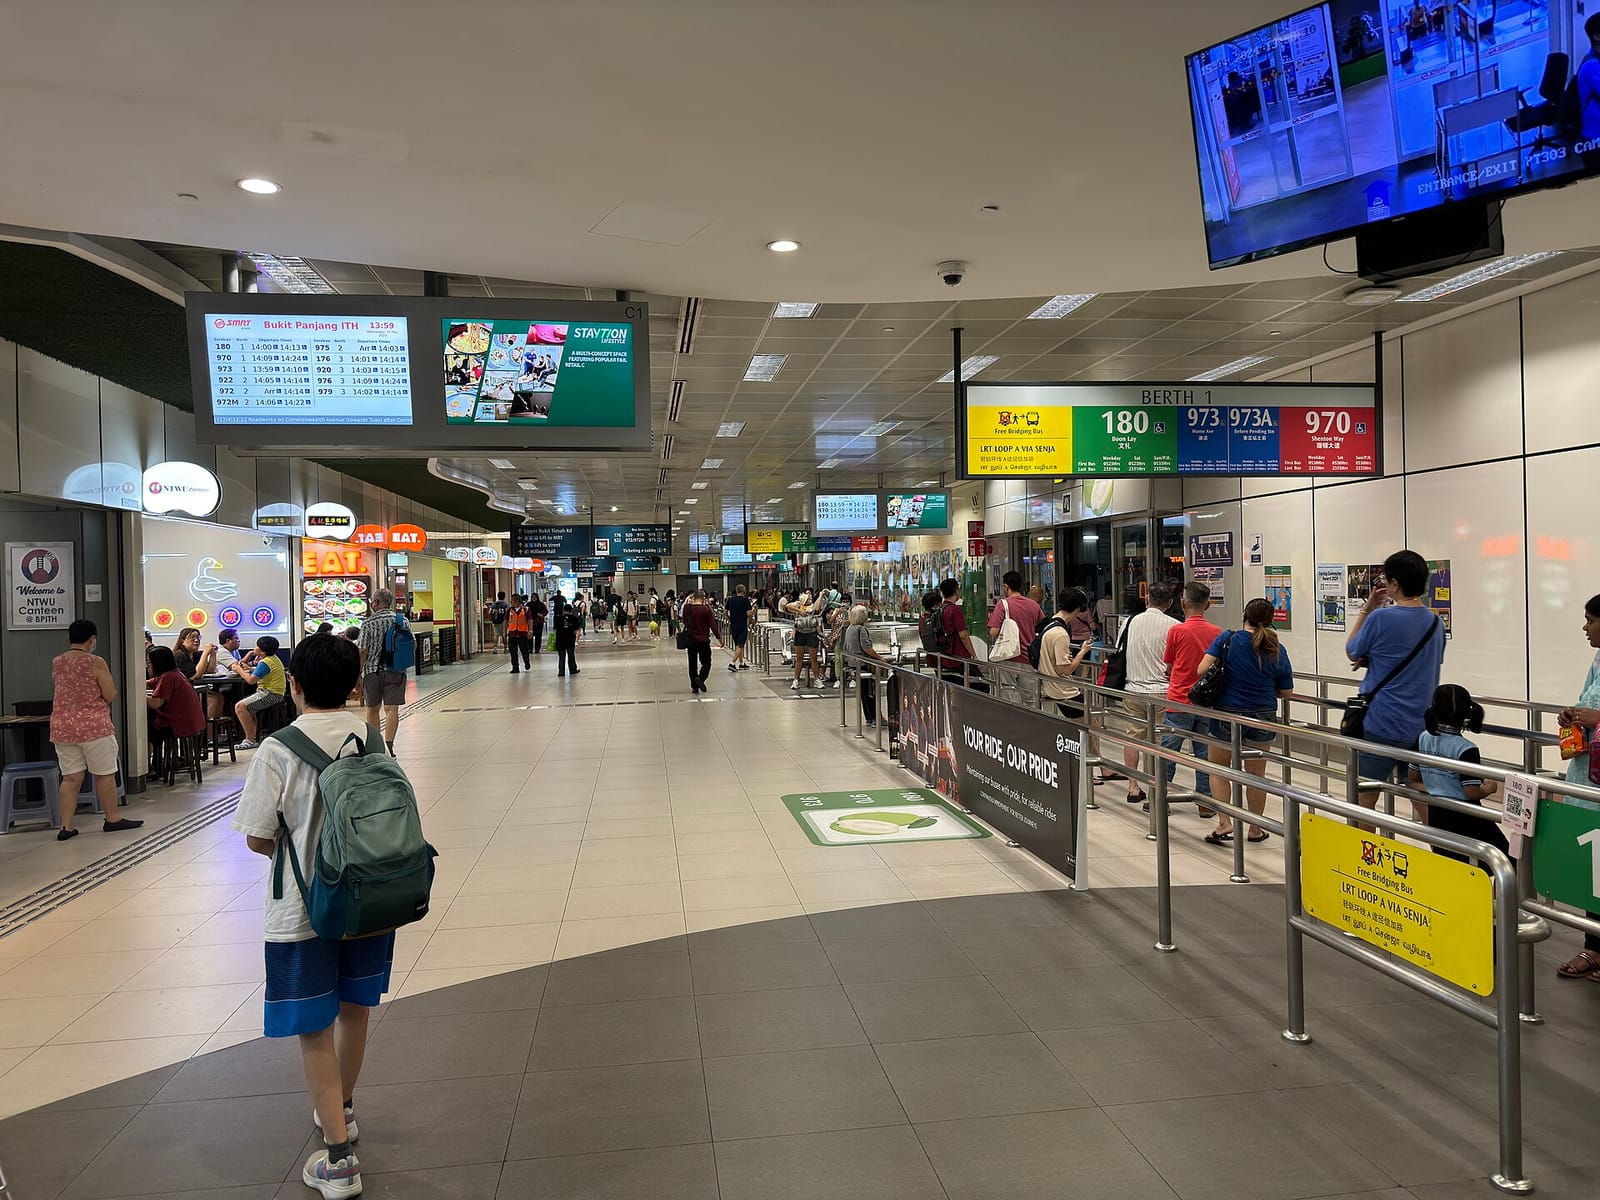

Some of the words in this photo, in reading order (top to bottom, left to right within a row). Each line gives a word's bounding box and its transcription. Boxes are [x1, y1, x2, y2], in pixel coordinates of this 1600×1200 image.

[1418, 160, 1518, 194] ENTRANCE/EXIT
[1524, 148, 1566, 166] PT303
[624, 306, 642, 318] C1
[264, 321, 292, 329] Bukit
[296, 322, 338, 331] Panjang
[1142, 390, 1194, 404] BERTH
[1205, 390, 1212, 404] 1
[1101, 410, 1149, 434] 180
[1188, 408, 1220, 426] 973
[1230, 408, 1272, 426] 973A
[1306, 411, 1350, 434] 970
[392, 532, 421, 543] EAT.
[791, 532, 808, 540] 922
[303, 551, 368, 575] EAT.
[16, 586, 55, 595] Welcome
[27, 598, 55, 606] NTWU
[963, 724, 984, 753] YOUR
[984, 734, 1004, 768] RIDE,
[1007, 744, 1027, 774] OUR
[1029, 752, 1058, 788] PRIDE
[966, 764, 985, 784] Maintaining
[990, 776, 1000, 791] buses
[1010, 790, 1021, 804] pride,
[1028, 799, 1044, 814] reliable
[1044, 808, 1056, 821] rides
[1512, 781, 1523, 790] 180
[1358, 866, 1371, 878] Free
[1372, 871, 1400, 891] Bridging
[1401, 882, 1413, 895] Bus
[1342, 882, 1355, 896] LRT
[1358, 888, 1378, 904] LOOP
[1380, 898, 1386, 909] A
[1388, 900, 1402, 915] VIA
[1404, 907, 1429, 927] SENJA
